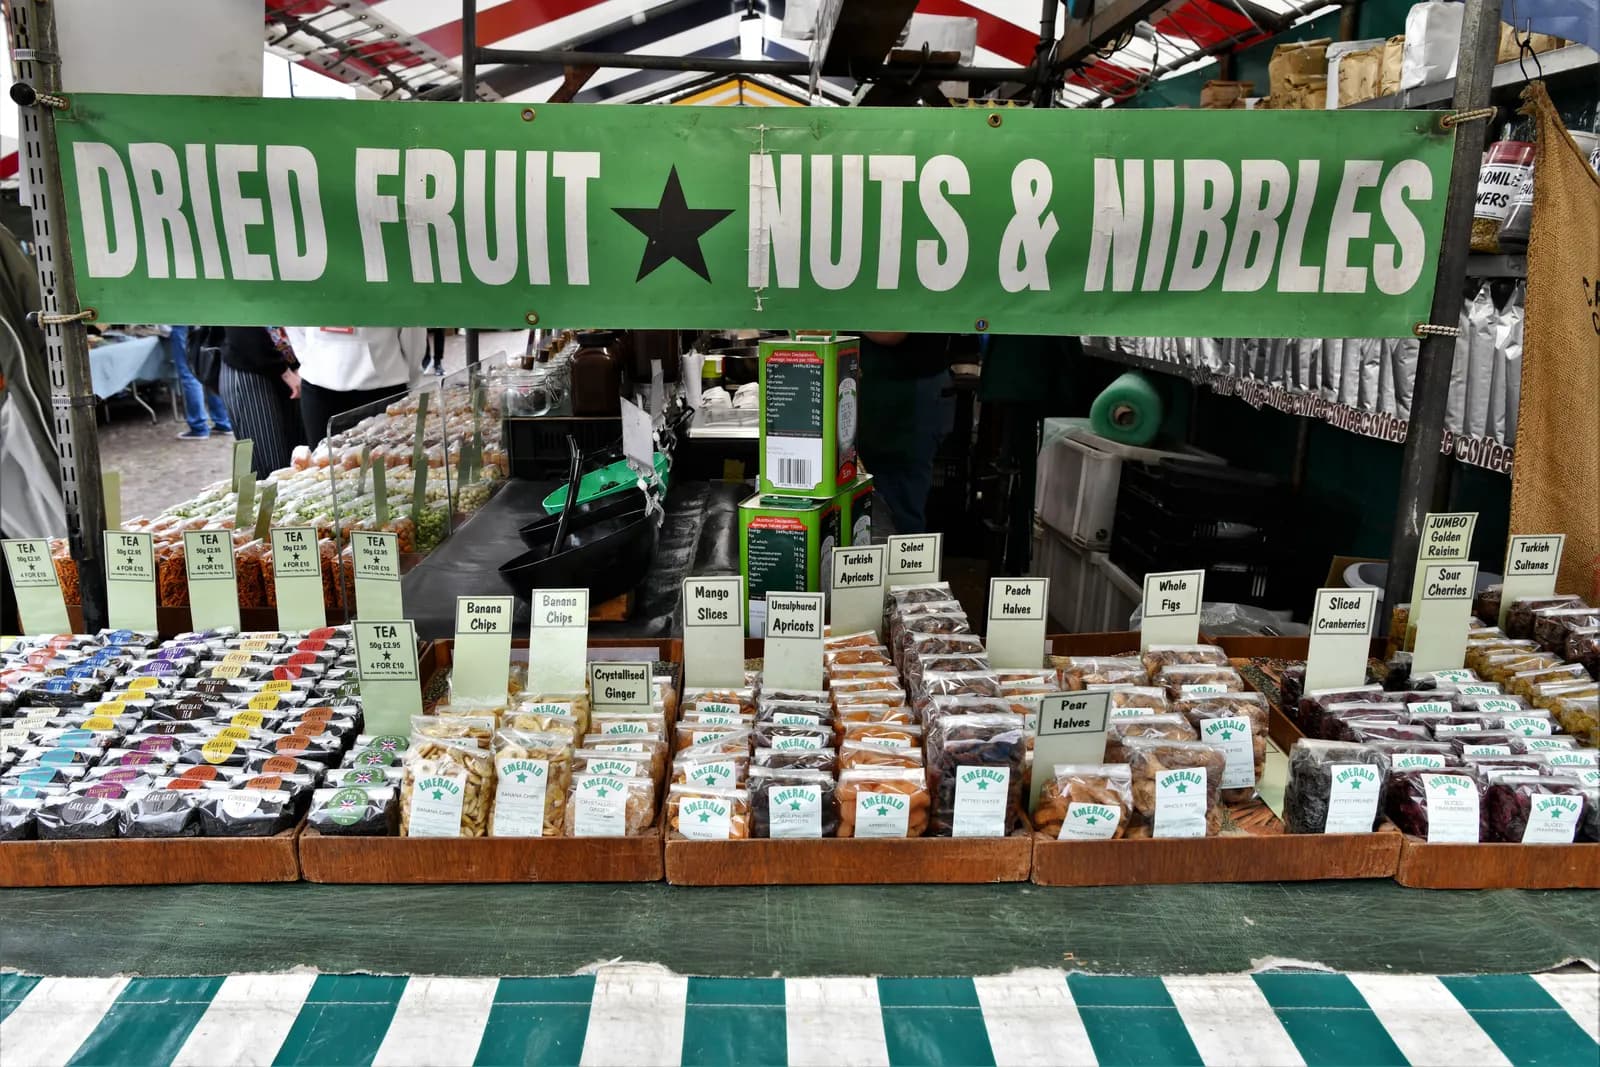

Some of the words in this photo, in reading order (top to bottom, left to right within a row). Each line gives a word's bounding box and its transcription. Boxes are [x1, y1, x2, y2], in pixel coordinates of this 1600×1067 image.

[72, 141, 328, 281] DRIED
[355, 147, 600, 286] FRUIT
[747, 154, 971, 291] NUTS
[999, 158, 1060, 291] &
[1084, 159, 1433, 295] NIBBLES
[1360, 412, 1408, 443] coffee
[1456, 436, 1513, 472] coffee
[1430, 517, 1468, 529] JUMBO
[121, 536, 139, 546] TEA
[200, 534, 219, 544] TEA
[284, 532, 303, 542] TEA
[367, 537, 385, 546] TEA
[1431, 531, 1461, 542] Golden
[17, 544, 36, 553] TEA
[900, 542, 924, 552] Select
[1428, 545, 1459, 556] Raisins
[1520, 541, 1550, 553] Turkish
[843, 553, 873, 565] Turkish
[901, 559, 922, 569] Dates
[1514, 559, 1549, 570] Sultanas
[840, 572, 874, 584] Apricots
[1438, 568, 1461, 580] Sour
[1005, 584, 1031, 596] Peach
[1159, 579, 1187, 591] Whole
[1428, 583, 1467, 596] Cherries
[695, 586, 729, 600] Mango
[543, 595, 577, 607] Banana
[771, 600, 817, 612] Unsulphured
[1161, 599, 1181, 611] Figs
[1329, 597, 1361, 610] Sliced
[467, 602, 502, 614] Banana
[697, 608, 728, 620] Slices
[1002, 603, 1031, 615] Halves
[546, 611, 572, 626] Chips
[1318, 618, 1366, 630] Cranberries
[471, 619, 497, 632] Chips
[773, 618, 814, 634] Apricots
[373, 626, 397, 638] TEA
[369, 642, 382, 650] 50g
[595, 669, 645, 682] Crystallised
[205, 685, 215, 693] TEA
[605, 687, 636, 700] Ginger
[532, 704, 567, 715] MERALD
[1061, 700, 1087, 710] Pear
[1483, 700, 1516, 711] EMERALD
[182, 711, 192, 719] TEA
[165, 725, 175, 733] TEA
[1053, 717, 1090, 729] Halves
[1205, 720, 1246, 736] EMERALD
[1509, 718, 1546, 731] EMERALD
[222, 730, 246, 739] BANANA
[502, 761, 544, 777] EMERALD
[591, 761, 632, 775] EMERALD
[691, 764, 730, 780] EMERALD
[961, 769, 1004, 783] EMERALD
[1160, 771, 1202, 788] EMERALD
[1336, 767, 1375, 783] EMERALD
[418, 777, 460, 795] EMERALD
[582, 777, 624, 791] EMERALD
[1429, 776, 1470, 789] EMERALD
[162, 793, 177, 801] GREY
[774, 788, 816, 805] EMERALD
[861, 794, 904, 810] EMERALD
[683, 800, 726, 816] EMERALD
[1536, 796, 1578, 812] EMERALD
[1072, 806, 1115, 821] EMERALD
